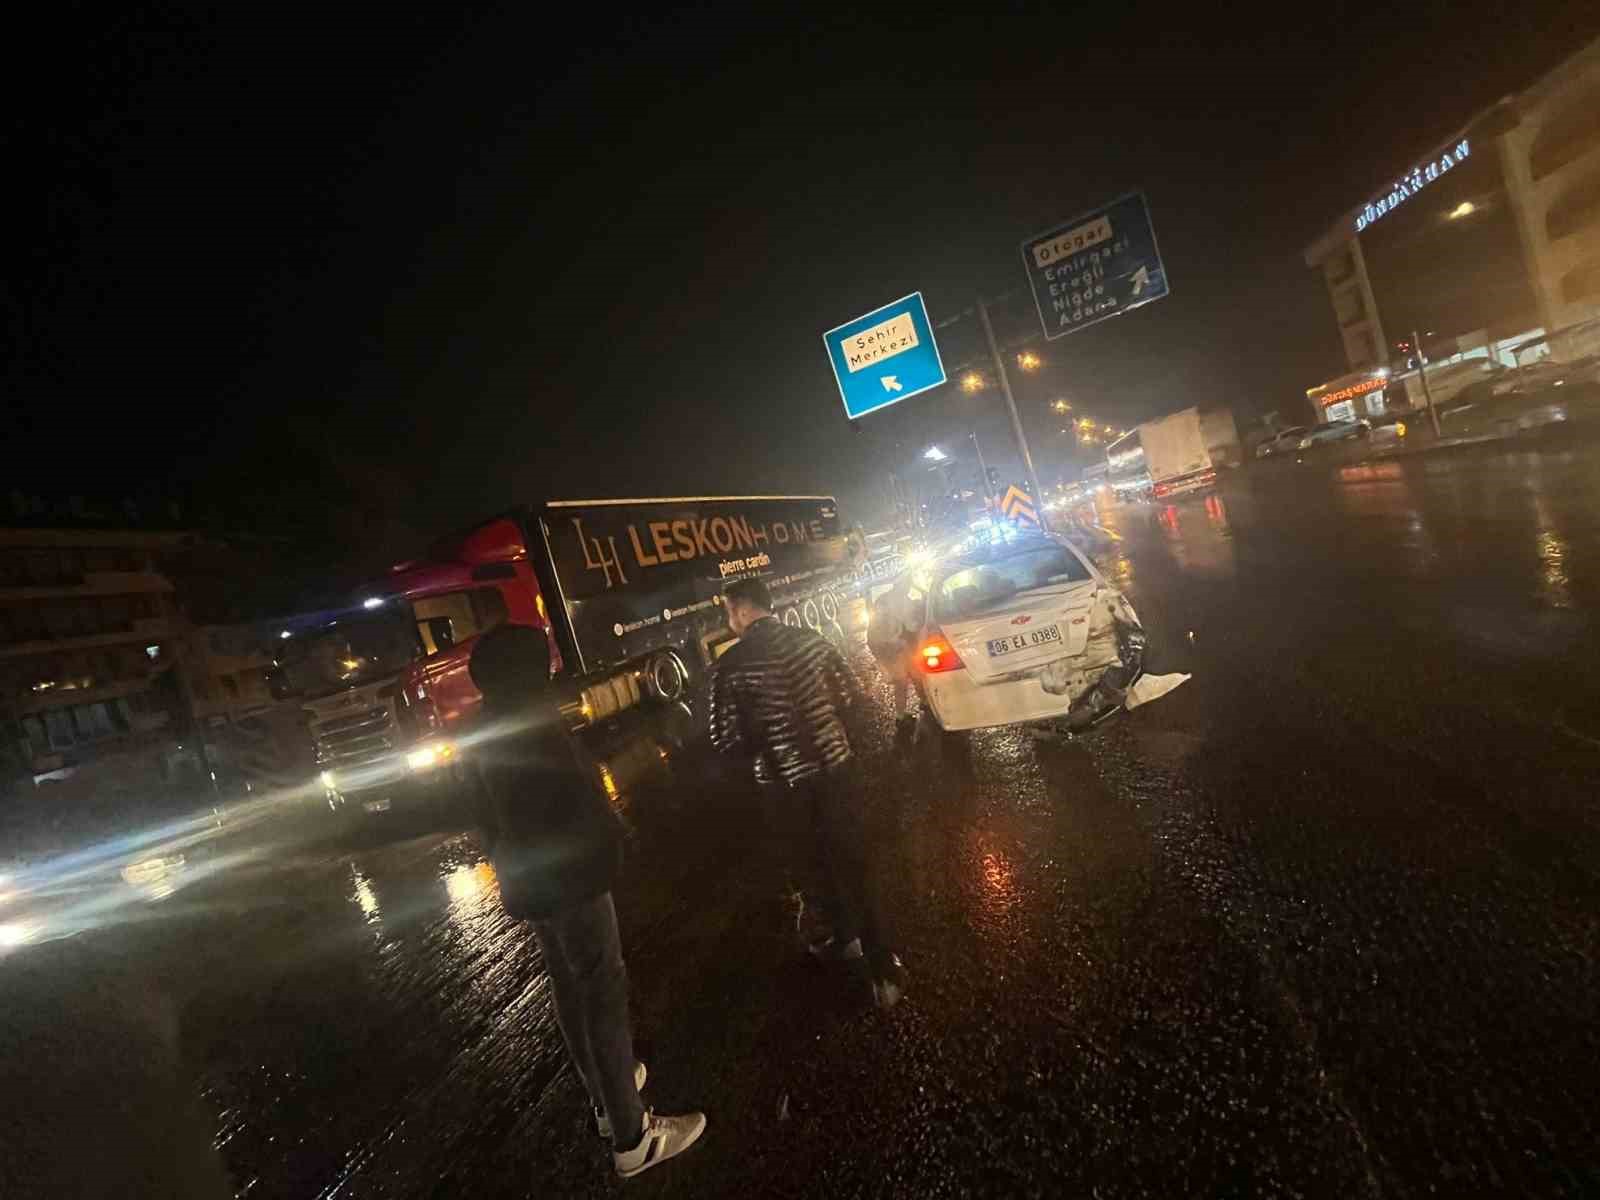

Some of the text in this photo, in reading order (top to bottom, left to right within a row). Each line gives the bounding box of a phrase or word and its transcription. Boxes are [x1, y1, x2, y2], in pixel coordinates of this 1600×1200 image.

[1040, 225, 1105, 261] Otogar
[1060, 296, 1117, 327] Adana
[850, 333, 913, 367] Merkezi
[628, 517, 825, 568] LESKON HOME
[719, 558, 745, 577] pierre
[994, 628, 1058, 653] 06 EA 0388
